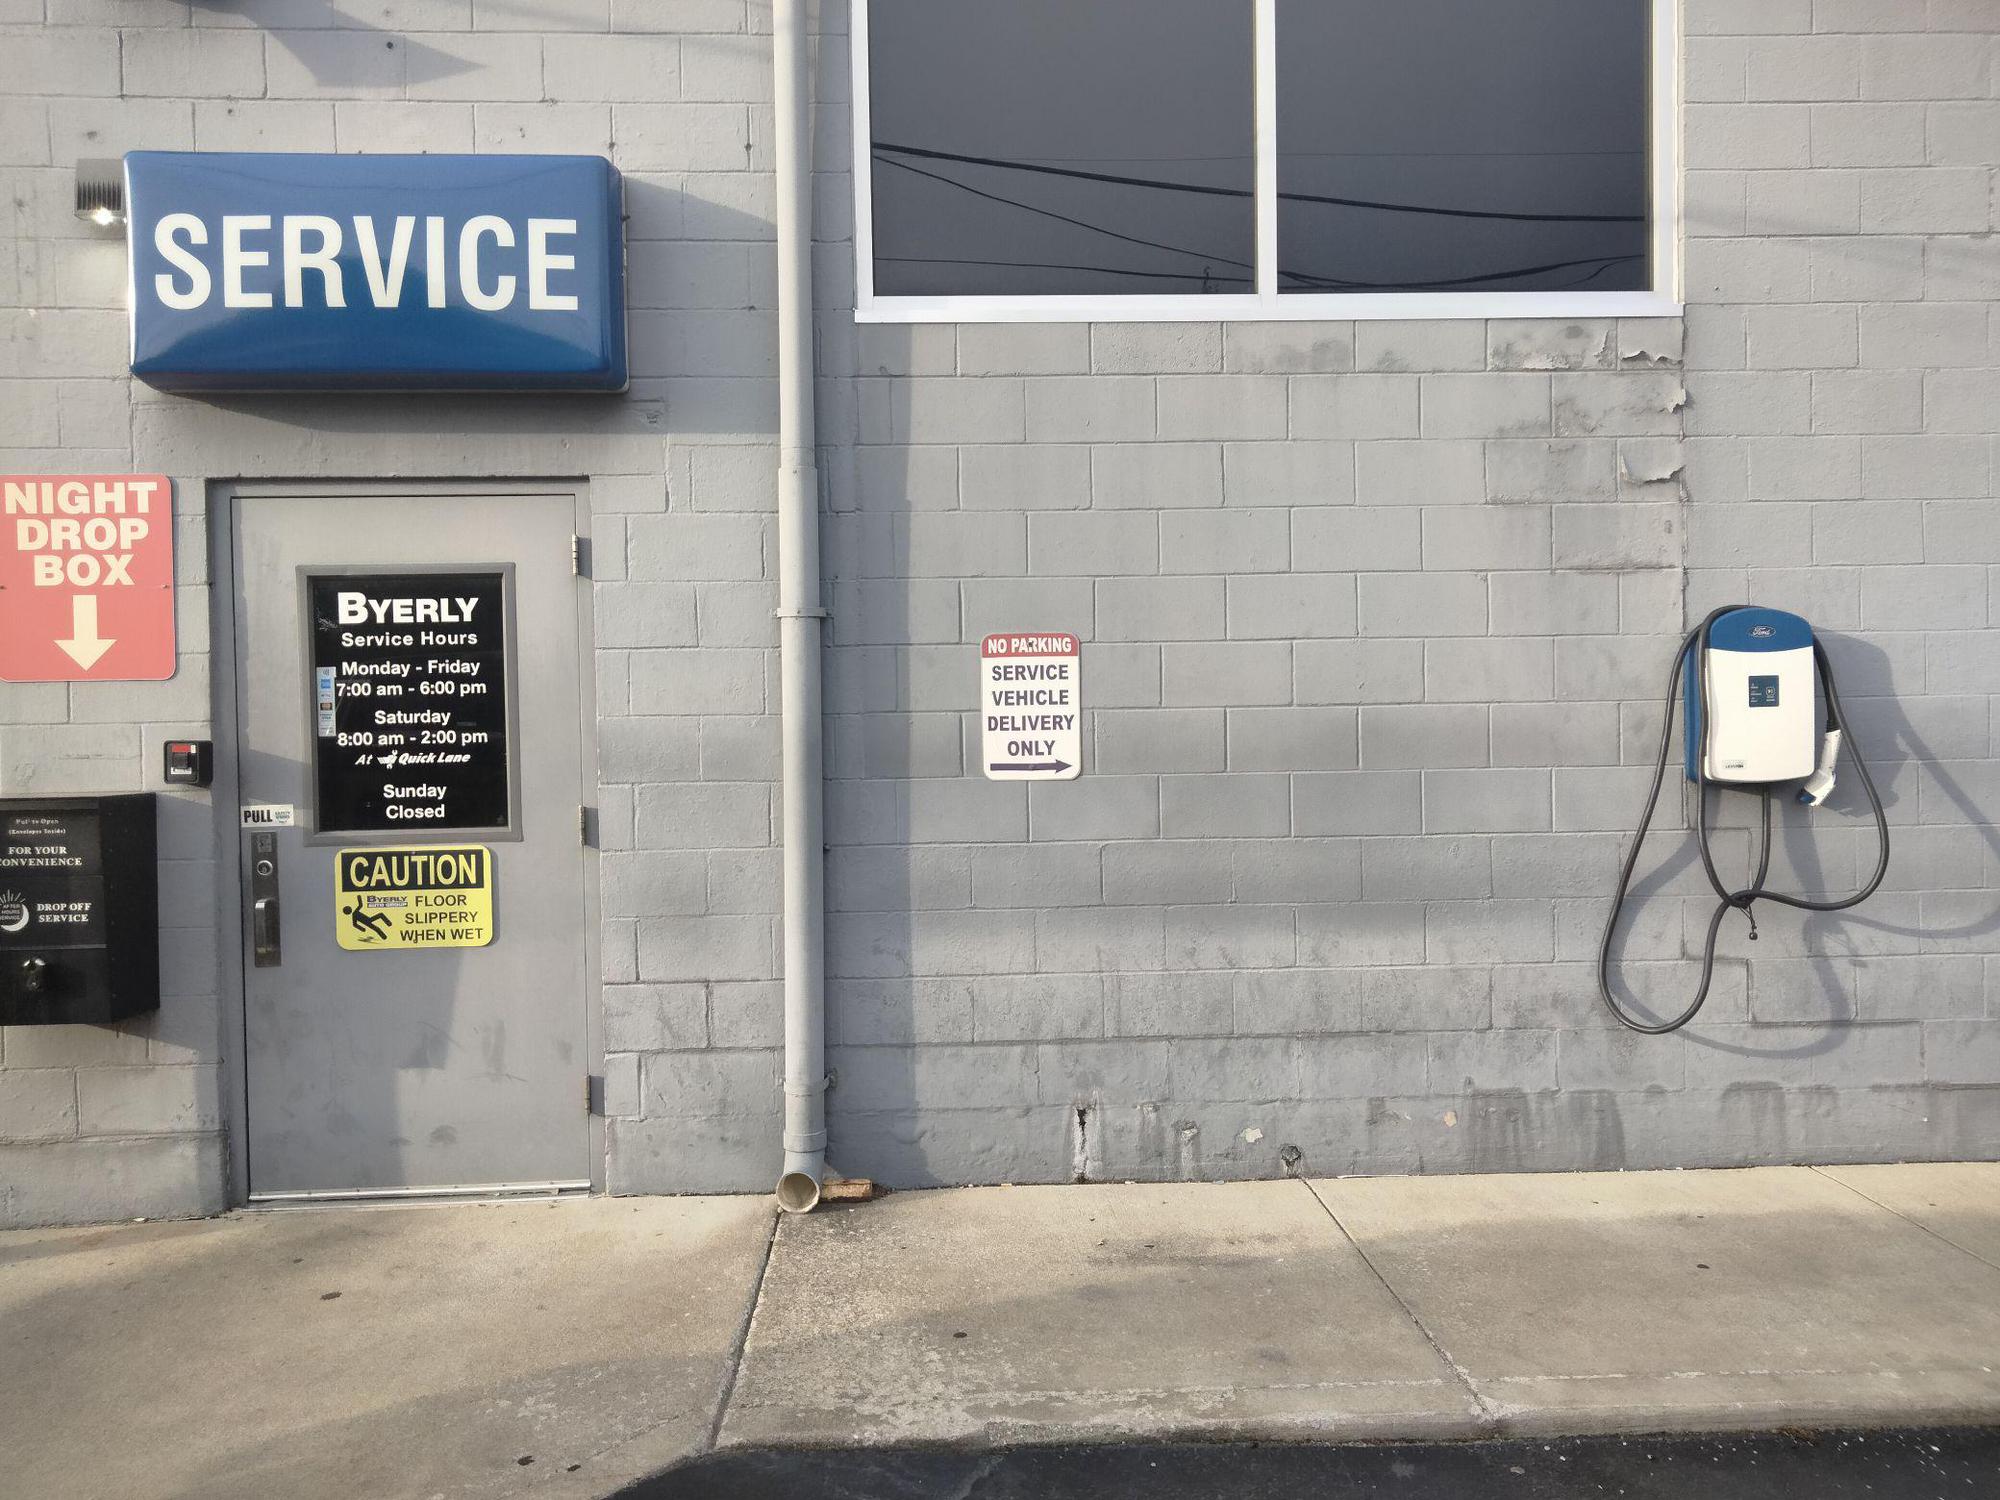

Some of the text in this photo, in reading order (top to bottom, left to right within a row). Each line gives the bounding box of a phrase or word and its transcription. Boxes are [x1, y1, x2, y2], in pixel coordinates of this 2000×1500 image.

[154, 213, 578, 311] SERVICE
[4, 481, 158, 514] NIGHT
[16, 518, 149, 551] DROP
[34, 554, 136, 586] BOX
[337, 591, 479, 625] BYERLY
[341, 631, 478, 647] Service Hours
[987, 637, 1072, 654] NO PARKING
[341, 661, 411, 677] Monday
[427, 660, 480, 676] Friday
[991, 664, 1069, 681] SERVICE
[336, 682, 371, 697] 7:00
[376, 685, 403, 696] am
[419, 681, 455, 695] 6:00
[459, 684, 487, 697] pm
[991, 689, 1069, 706] VEHICLE
[374, 709, 451, 726] Saturday
[987, 714, 1075, 732] DELIVERY
[337, 732, 373, 746] 8:00
[377, 734, 404, 746] am
[420, 730, 457, 745] 2:00
[461, 733, 488, 747] pm
[1007, 740, 1056, 756] ONLY
[355, 752, 471, 766] At Quick Lane
[383, 783, 447, 800] Sunday
[243, 809, 273, 823] PULL
[385, 804, 445, 819] Closed
[8, 846, 68, 855] FOR YOUR
[350, 854, 477, 888] CAUTION
[36, 902, 92, 912] DROP OFF
[415, 894, 467, 907] FLOOR
[38, 914, 89, 923] SERVICE
[404, 911, 478, 924] SLIPPERY
[400, 927, 484, 942] WHEN WET
